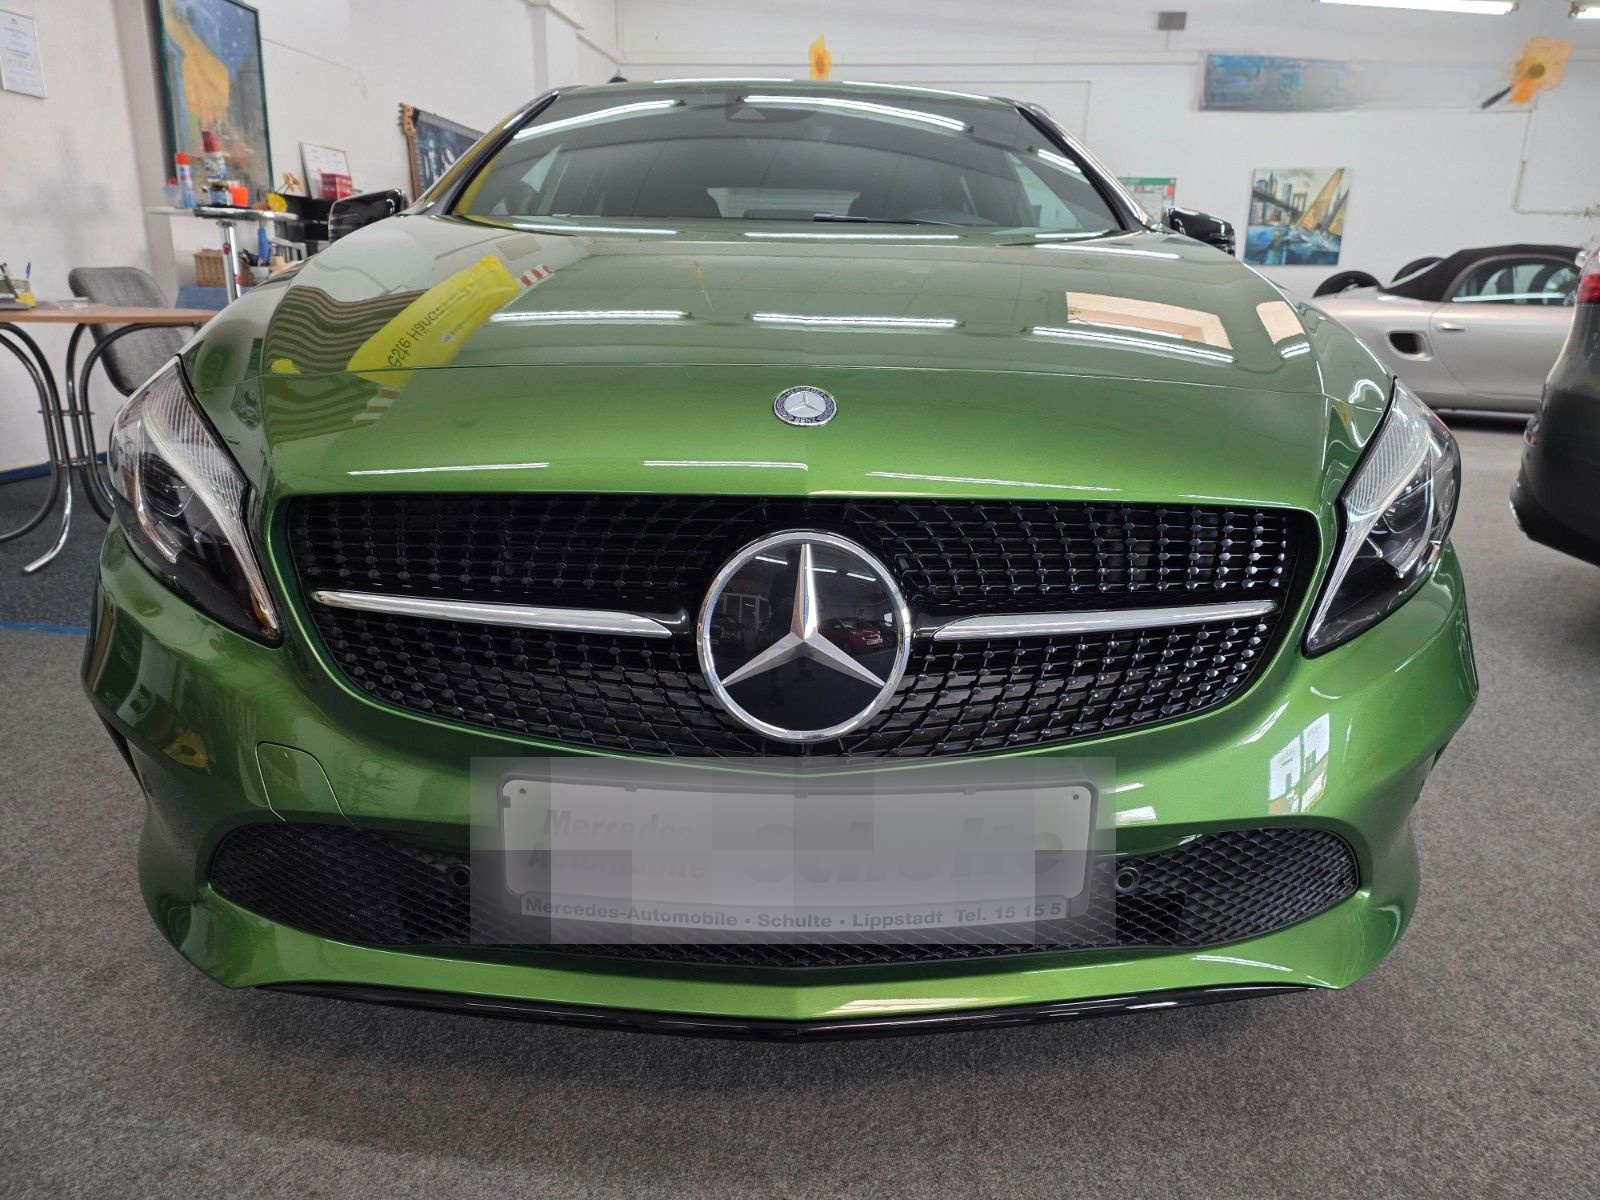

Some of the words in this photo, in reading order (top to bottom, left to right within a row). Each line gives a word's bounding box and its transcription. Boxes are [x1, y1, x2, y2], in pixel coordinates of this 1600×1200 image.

[541, 808, 692, 844] Mercedes
[741, 816, 1065, 884] Schulte
[524, 897, 738, 927] Mercedes-Automobile
[757, 913, 833, 929] Schulte
[852, 911, 944, 930] Lippstadt
[955, 909, 988, 923] Tel.
[994, 906, 1017, 920] 15
[1024, 904, 1045, 918] 15
[1050, 901, 1063, 916] 5
